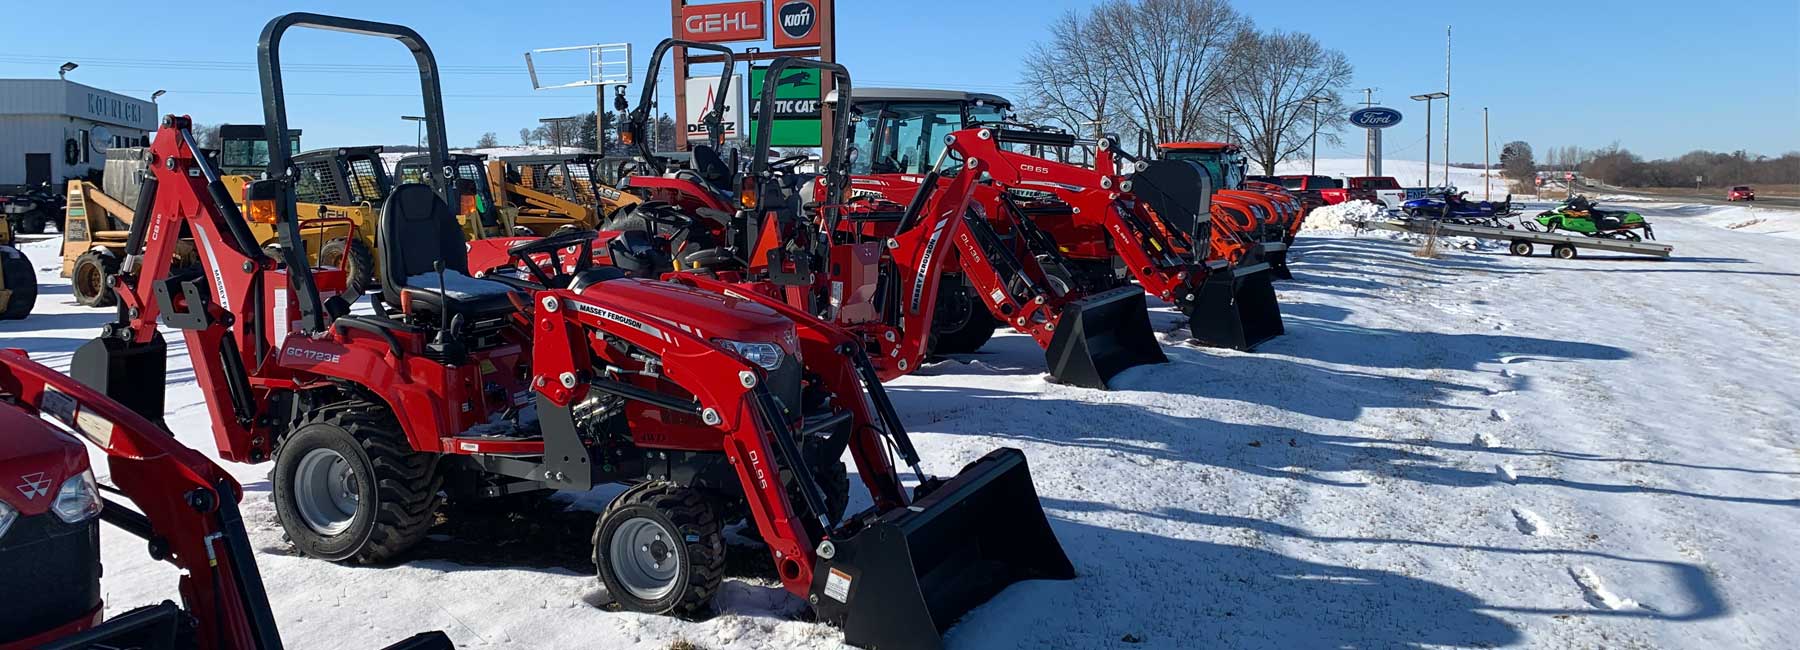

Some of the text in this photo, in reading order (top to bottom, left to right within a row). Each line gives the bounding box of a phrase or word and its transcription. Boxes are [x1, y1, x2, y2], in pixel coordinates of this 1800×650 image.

[685, 12, 758, 33] GEHL
[784, 8, 810, 27] KIOTI
[753, 100, 817, 113] ATIC CAT
[1360, 112, 1391, 123] Ford
[688, 122, 735, 133] DEZ
[598, 187, 620, 200] ASE
[919, 238, 937, 278] FERGUSON
[580, 304, 642, 329] MASSEY FERGUSON
[286, 346, 340, 364] GC1723E
[748, 450, 768, 489] DL95
